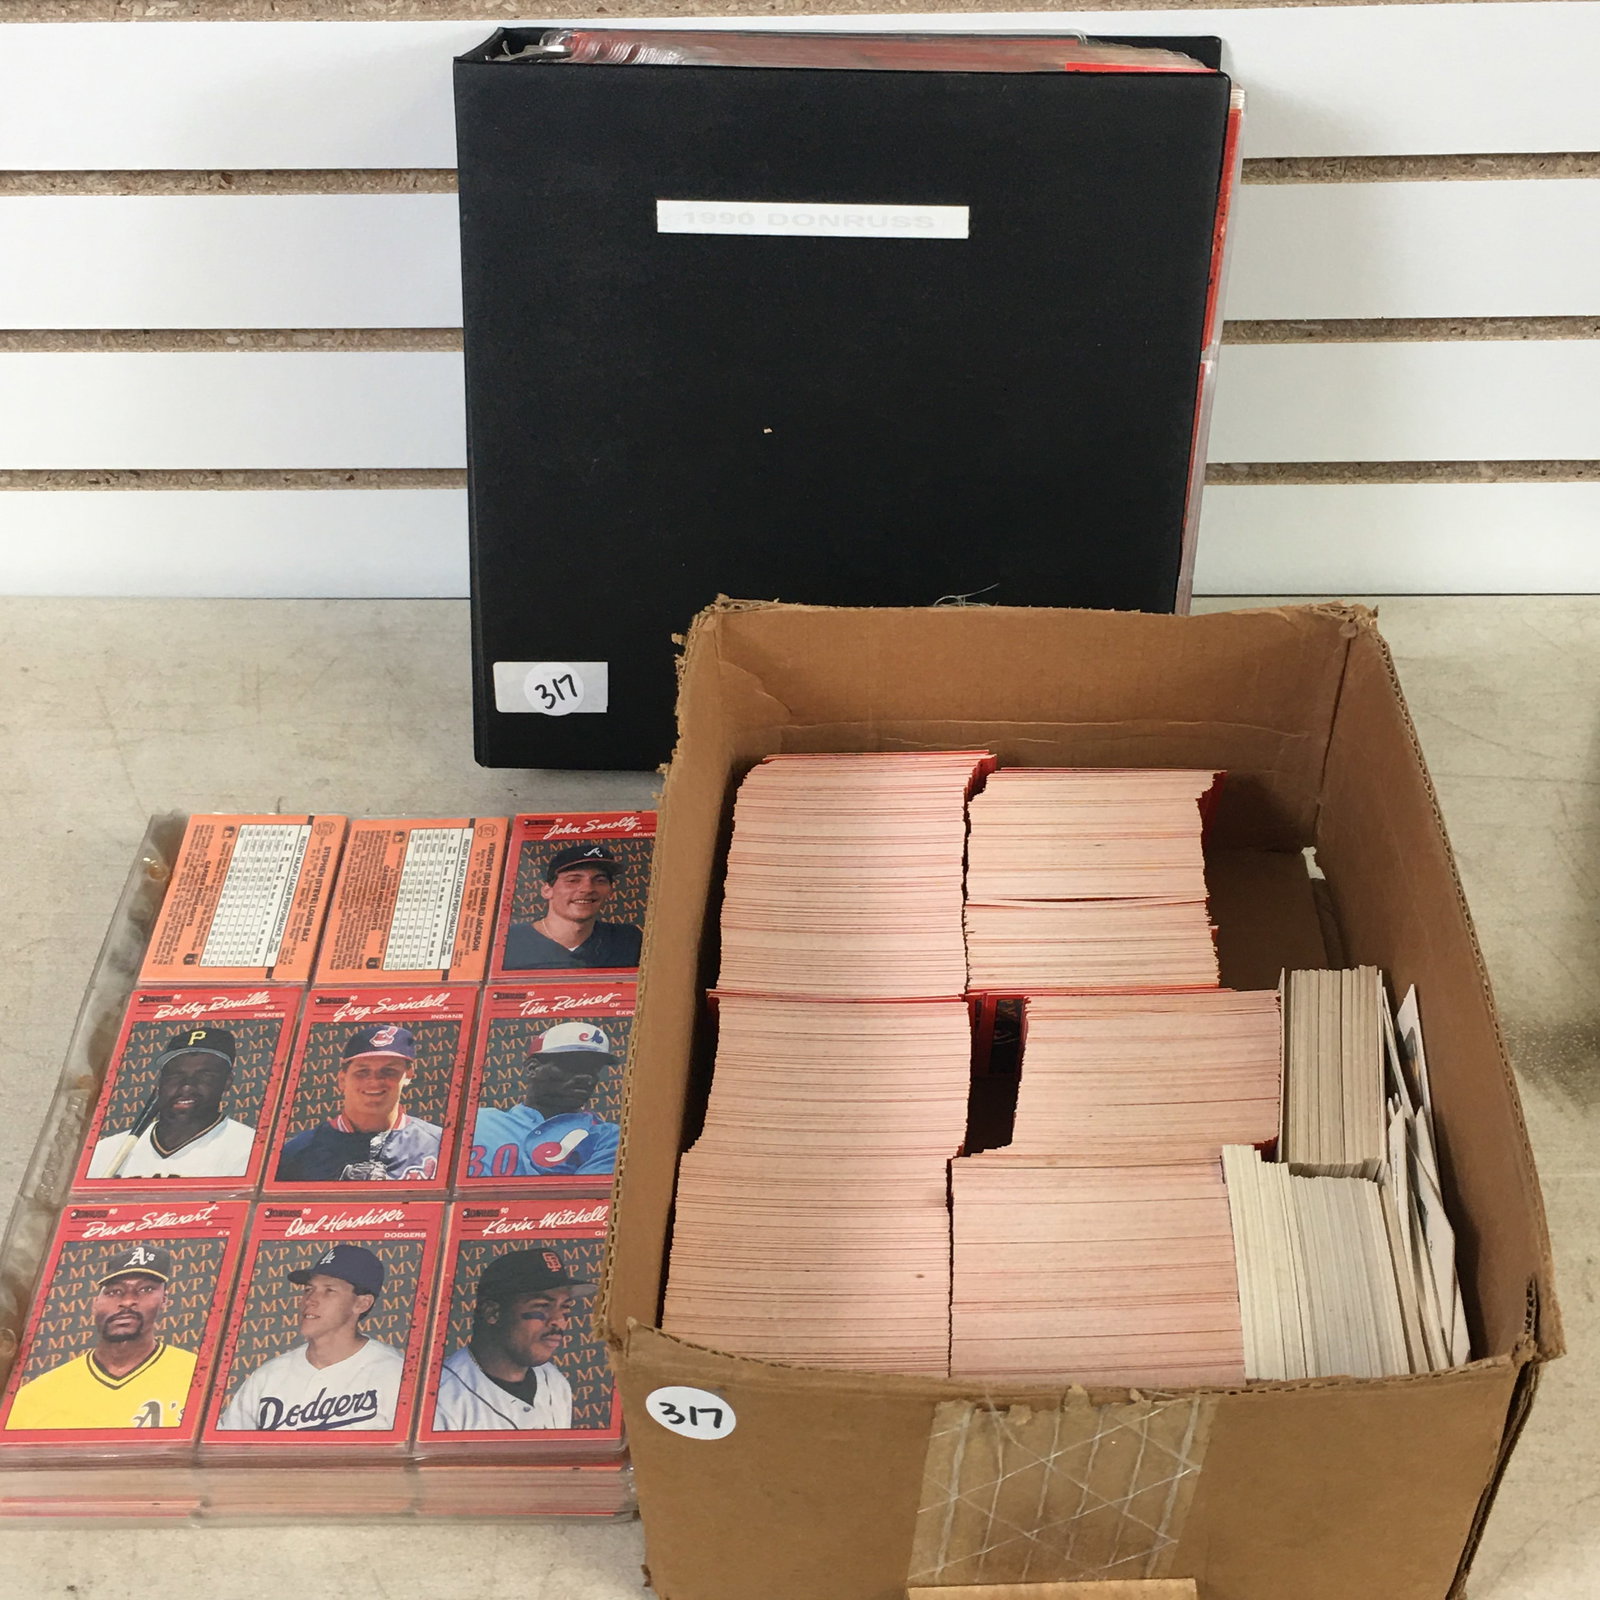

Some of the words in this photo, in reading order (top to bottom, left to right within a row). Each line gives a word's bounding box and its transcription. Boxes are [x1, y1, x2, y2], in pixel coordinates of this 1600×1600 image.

[684, 211, 755, 226] 1990
[768, 213, 935, 229] DONRUSS
[535, 674, 577, 709] 317
[543, 823, 580, 839] John
[582, 816, 640, 832] Smoltz
[296, 836, 306, 855] RECENT
[460, 839, 469, 857] RECENT
[584, 848, 603, 857] A
[291, 857, 301, 874] MAJOR
[457, 859, 466, 876] MAJOR
[285, 875, 296, 896] LEAGUE
[454, 878, 463, 898] LEAGUE
[626, 875, 650, 886] MV
[522, 903, 546, 914] MV
[600, 904, 617, 916] VP
[624, 900, 647, 911] MV
[274, 897, 290, 937] PERFORMANCE
[446, 899, 459, 939] PERFORMANCE
[300, 927, 310, 941] SAX
[472, 917, 483, 950] JACKSON
[154, 1002, 207, 1019] Bobby
[208, 991, 270, 1011] Bonilla
[333, 1002, 371, 1022] Greg
[373, 993, 450, 1013] Swindell
[520, 998, 549, 1016] Tim
[551, 993, 621, 1011] Raines
[130, 1029, 159, 1043] VP
[187, 1030, 207, 1045] P
[309, 1030, 338, 1044] VP
[490, 1024, 519, 1038] VP
[502, 1037, 532, 1050] MV
[603, 1021, 628, 1032] VP
[119, 1059, 151, 1072] VP
[250, 1039, 276, 1050] MV
[139, 1041, 169, 1055] MV
[303, 1059, 332, 1072] VP
[428, 1040, 455, 1052] MV
[319, 1042, 347, 1056] MV
[131, 1070, 159, 1083] MV
[234, 1053, 262, 1067] VP
[485, 1054, 515, 1068] VP
[243, 1067, 269, 1079] MV
[313, 1072, 340, 1086] MV
[413, 1055, 442, 1069] VP
[424, 1070, 449, 1081] MV
[497, 1068, 523, 1080] MV
[123, 1099, 146, 1113] MV
[228, 1082, 255, 1096] VP
[481, 1083, 511, 1097] VP
[493, 1095, 528, 1109] MV
[599, 1080, 623, 1092] VP
[235, 1096, 262, 1108] MV
[419, 1099, 444, 1110] MV
[597, 1110, 621, 1123] VP
[82, 1221, 135, 1238] Dave
[136, 1204, 219, 1231] Stewart
[285, 1215, 328, 1237] Orel
[323, 1208, 405, 1232] Hershiser
[482, 1217, 536, 1236] Kevin
[539, 1206, 608, 1228] Mitchell
[60, 1248, 93, 1264] VP
[124, 1247, 155, 1267] A's
[257, 1247, 289, 1263] VP
[461, 1247, 486, 1263] VP
[492, 1240, 534, 1256] MVP
[50, 1282, 83, 1299] VP
[189, 1256, 219, 1271] MV
[70, 1263, 107, 1279] MV
[250, 1282, 283, 1298] VP
[389, 1260, 419, 1275] MV
[382, 1279, 404, 1294] VP
[58, 1298, 91, 1313] MV
[180, 1294, 213, 1308] MV
[242, 1317, 275, 1333] VP
[383, 1297, 413, 1311] MV
[49, 1332, 93, 1349] MVP
[172, 1329, 200, 1344] MV
[252, 1331, 297, 1348] MVP
[377, 1330, 409, 1345] MV
[553, 1349, 597, 1367] MVP
[577, 1367, 612, 1381] MV
[572, 1386, 593, 1400] VP
[258, 1387, 378, 1430] Dodgers
[574, 1402, 607, 1419] MV
[659, 1402, 722, 1429] 317
